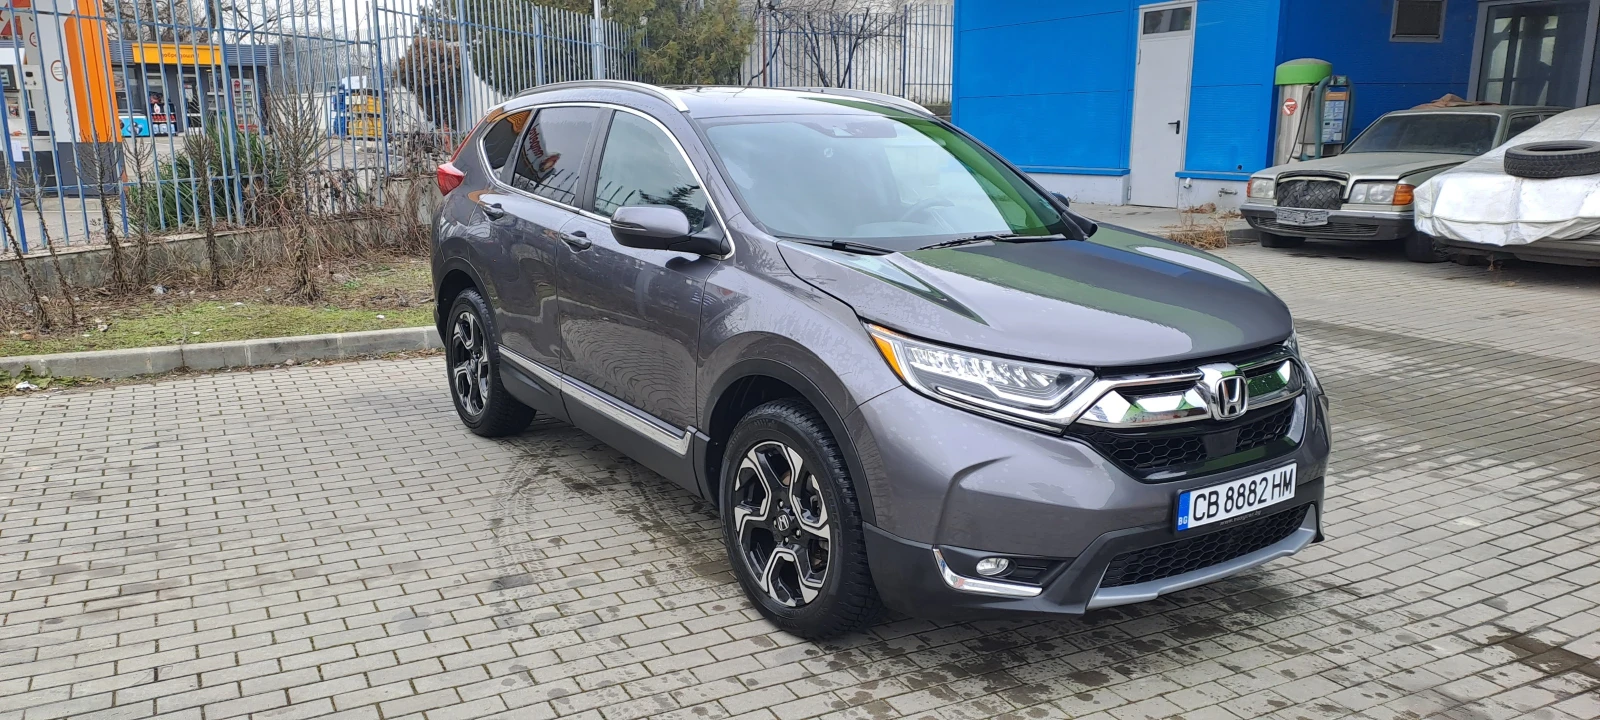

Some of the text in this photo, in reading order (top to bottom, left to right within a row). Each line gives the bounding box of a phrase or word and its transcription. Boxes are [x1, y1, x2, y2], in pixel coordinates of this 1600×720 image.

[1192, 468, 1294, 522] CB 8882 HM
[1178, 516, 1188, 526] BG
